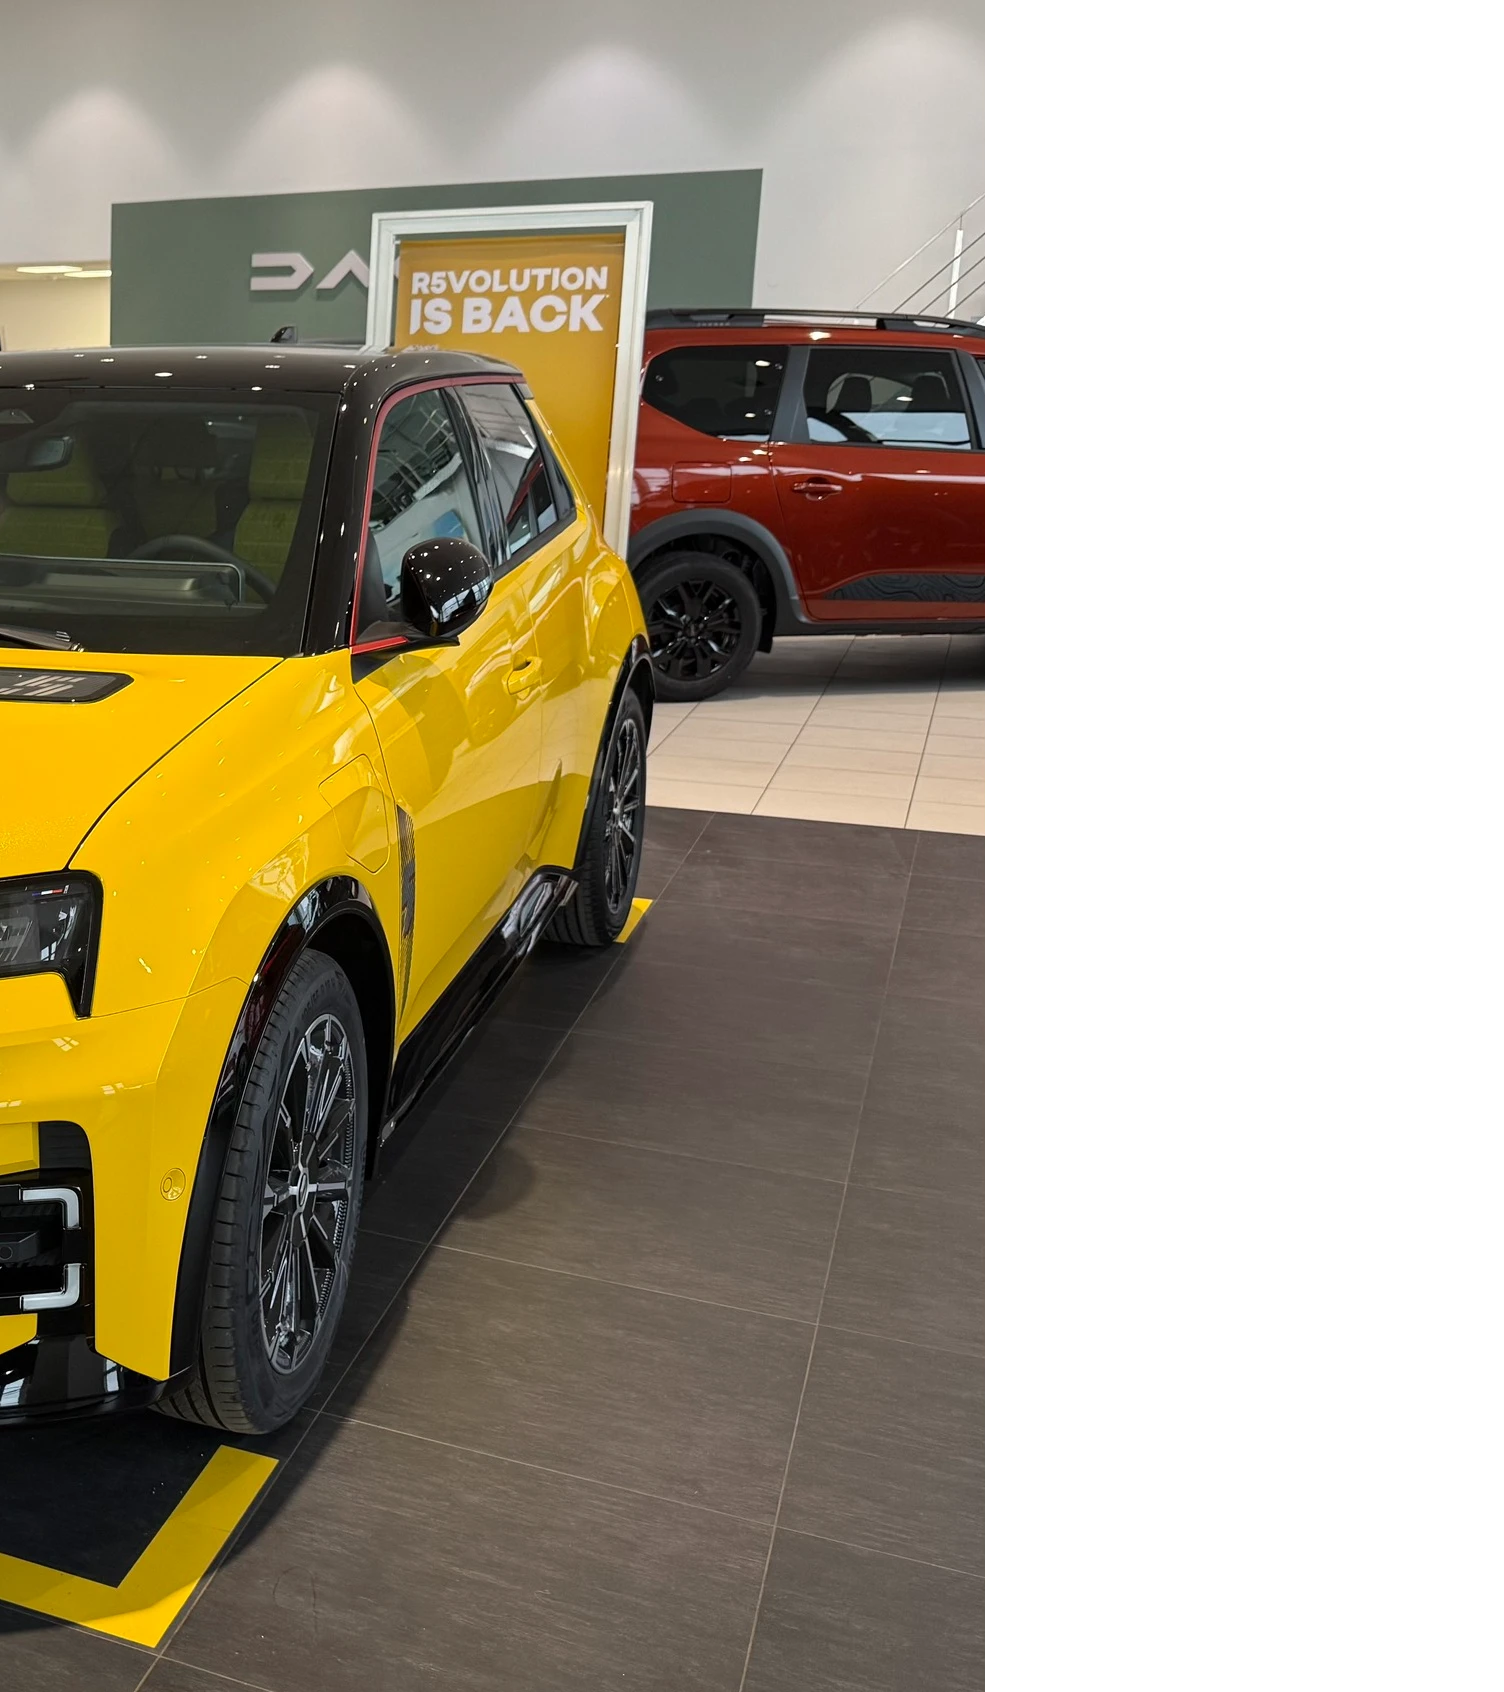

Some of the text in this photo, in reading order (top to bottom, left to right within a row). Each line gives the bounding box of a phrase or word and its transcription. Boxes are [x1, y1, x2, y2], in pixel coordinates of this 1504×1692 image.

[411, 266, 608, 295] R5VOLUTION
[409, 294, 606, 335] IS BACK
